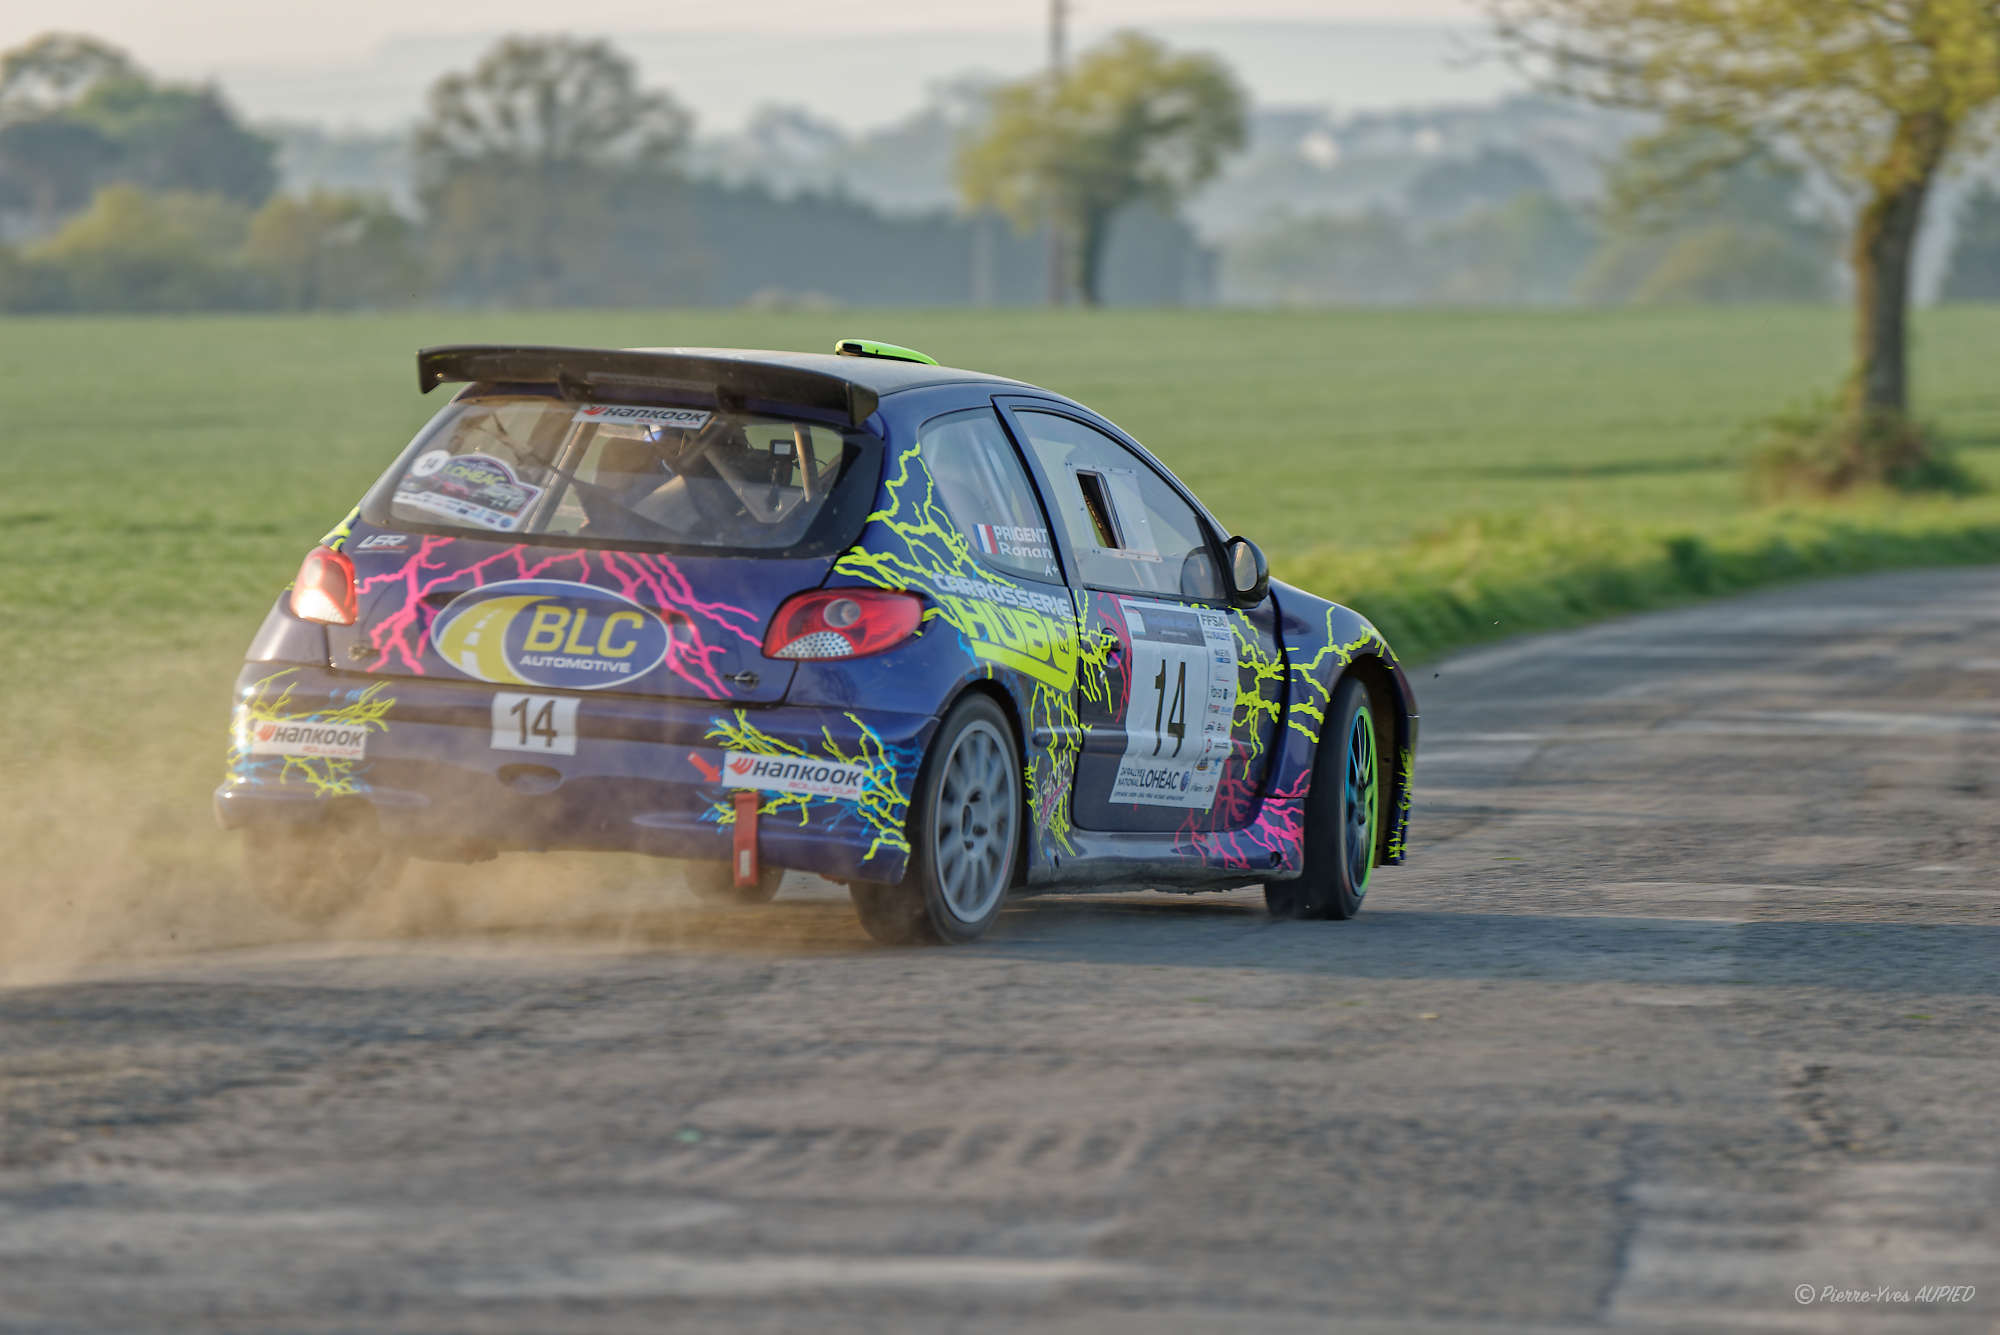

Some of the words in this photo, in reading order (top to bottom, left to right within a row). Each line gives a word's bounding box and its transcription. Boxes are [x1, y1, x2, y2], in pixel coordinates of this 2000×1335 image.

[993, 524, 1048, 544] PRIGENT
[998, 542, 1053, 560] Ronan
[1045, 564, 1059, 577] A+
[931, 571, 1074, 619] CARROSSERIE
[522, 605, 645, 658] BLC
[520, 655, 632, 674] AUTOMOTIVE
[1152, 659, 1186, 758] 14
[510, 697, 558, 748] 14
[1139, 768, 1180, 790] LOHÉAC
